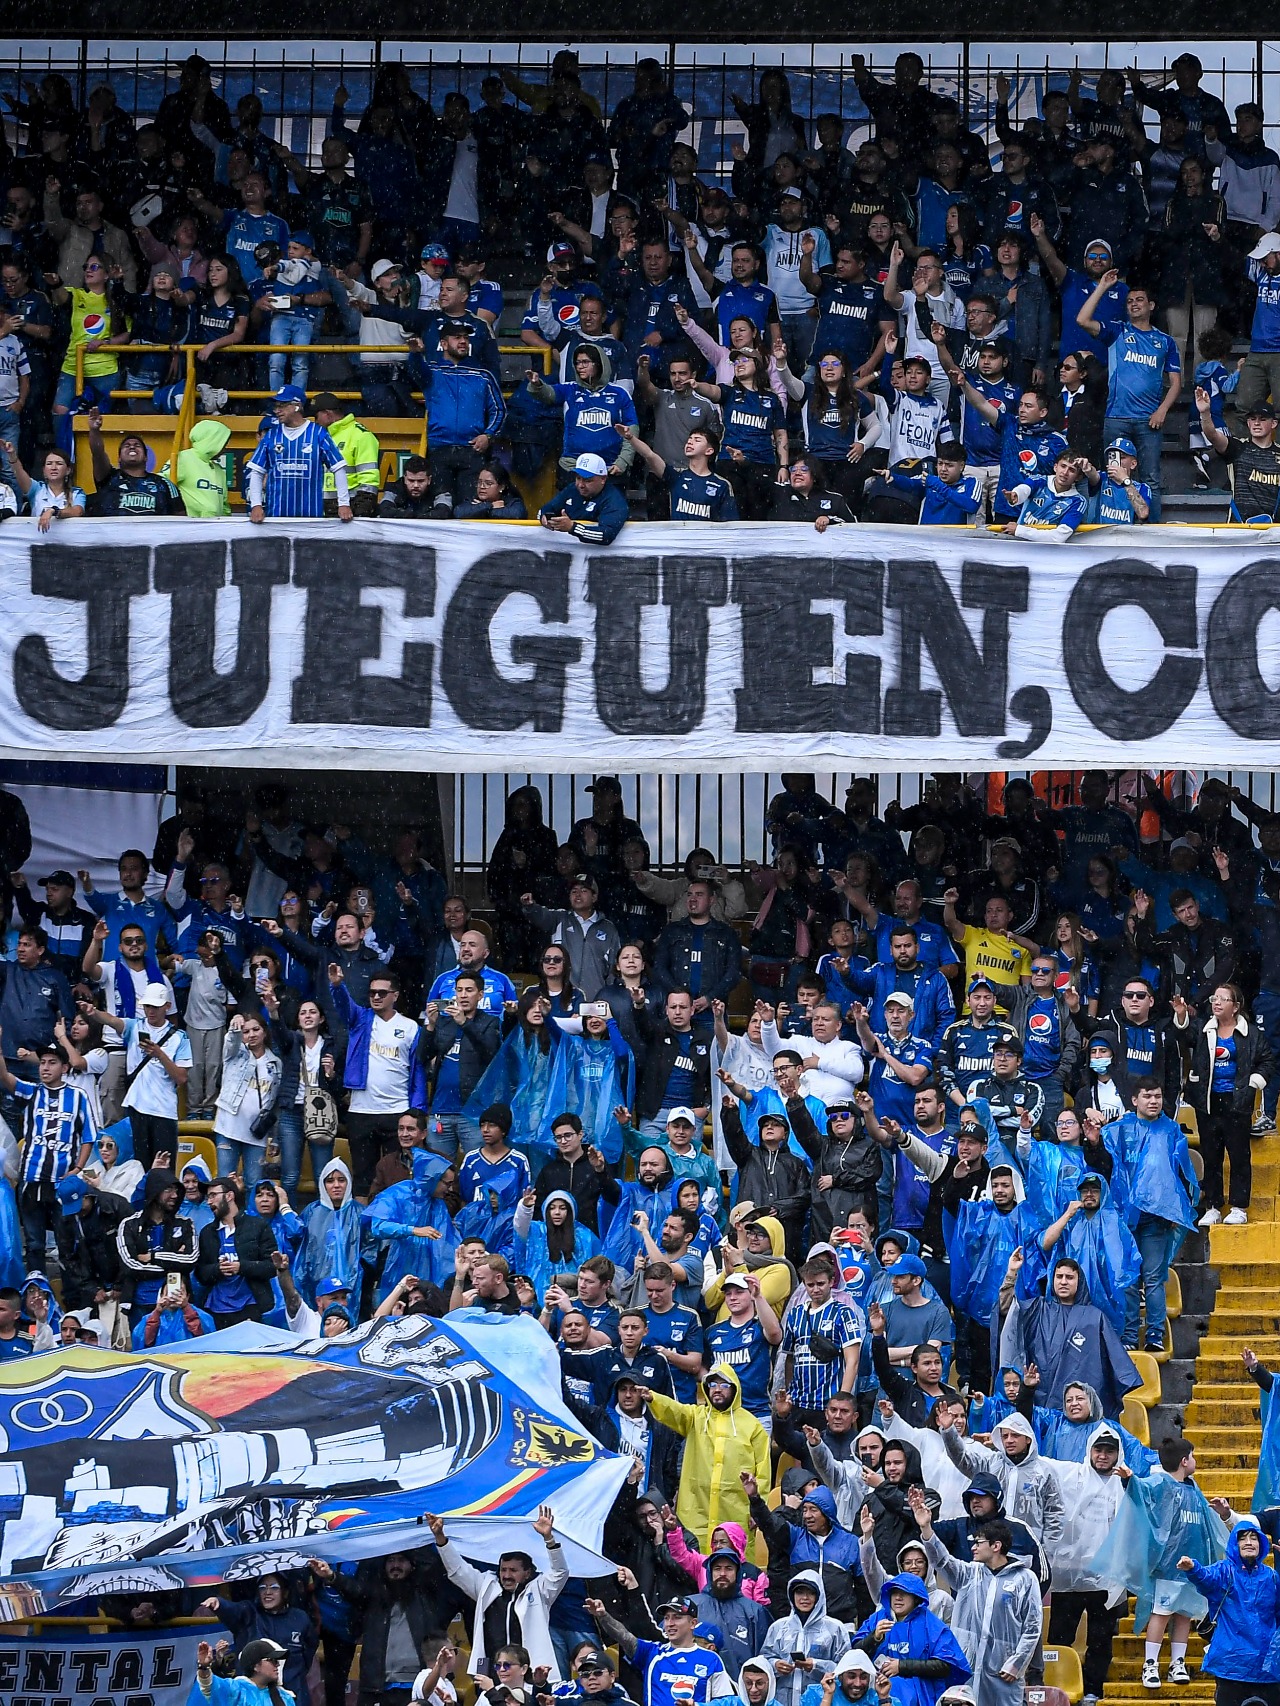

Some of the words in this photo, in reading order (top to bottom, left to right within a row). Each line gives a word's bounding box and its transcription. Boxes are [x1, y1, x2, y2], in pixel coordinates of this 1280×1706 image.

[829, 301, 867, 320] ANDINA
[1124, 350, 1157, 368] ANDINA
[576, 411, 612, 427] ANDINA
[731, 410, 767, 430] ANDINA
[676, 498, 711, 519] ANDINA
[14, 536, 1053, 758] JUEGUEN,
[976, 952, 1016, 973] ANDINA
[1028, 1035, 1050, 1045] pepsi
[36, 1107, 74, 1123] PEPSI
[34, 1136, 72, 1152] SAETA
[660, 1672, 698, 1687] PEPSI
